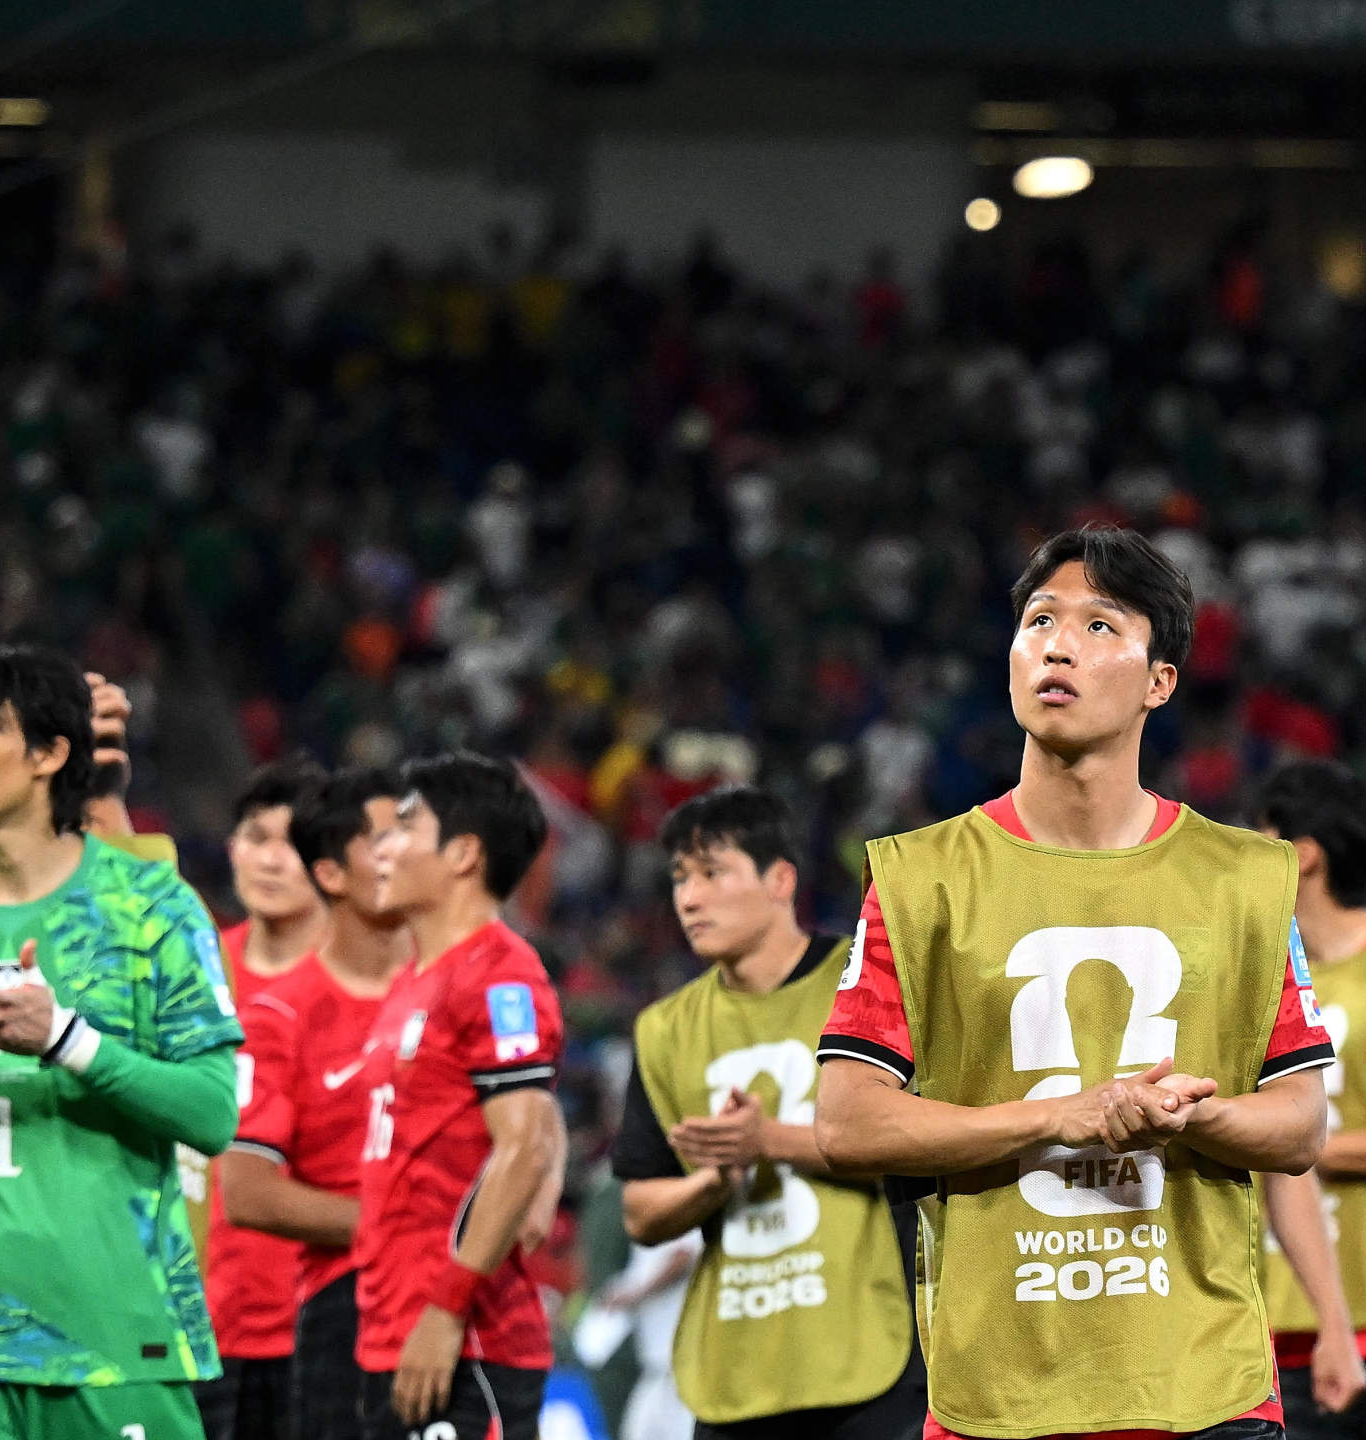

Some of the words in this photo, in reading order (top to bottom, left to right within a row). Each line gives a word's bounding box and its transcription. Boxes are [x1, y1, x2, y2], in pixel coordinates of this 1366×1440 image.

[361, 1083, 396, 1163] 16
[1063, 1157, 1143, 1190] FIFA
[1014, 1226, 1125, 1257] WORLD
[1131, 1224, 1168, 1249] CUP
[717, 1273, 828, 1321] 2026
[1014, 1256, 1171, 1303] 2026
